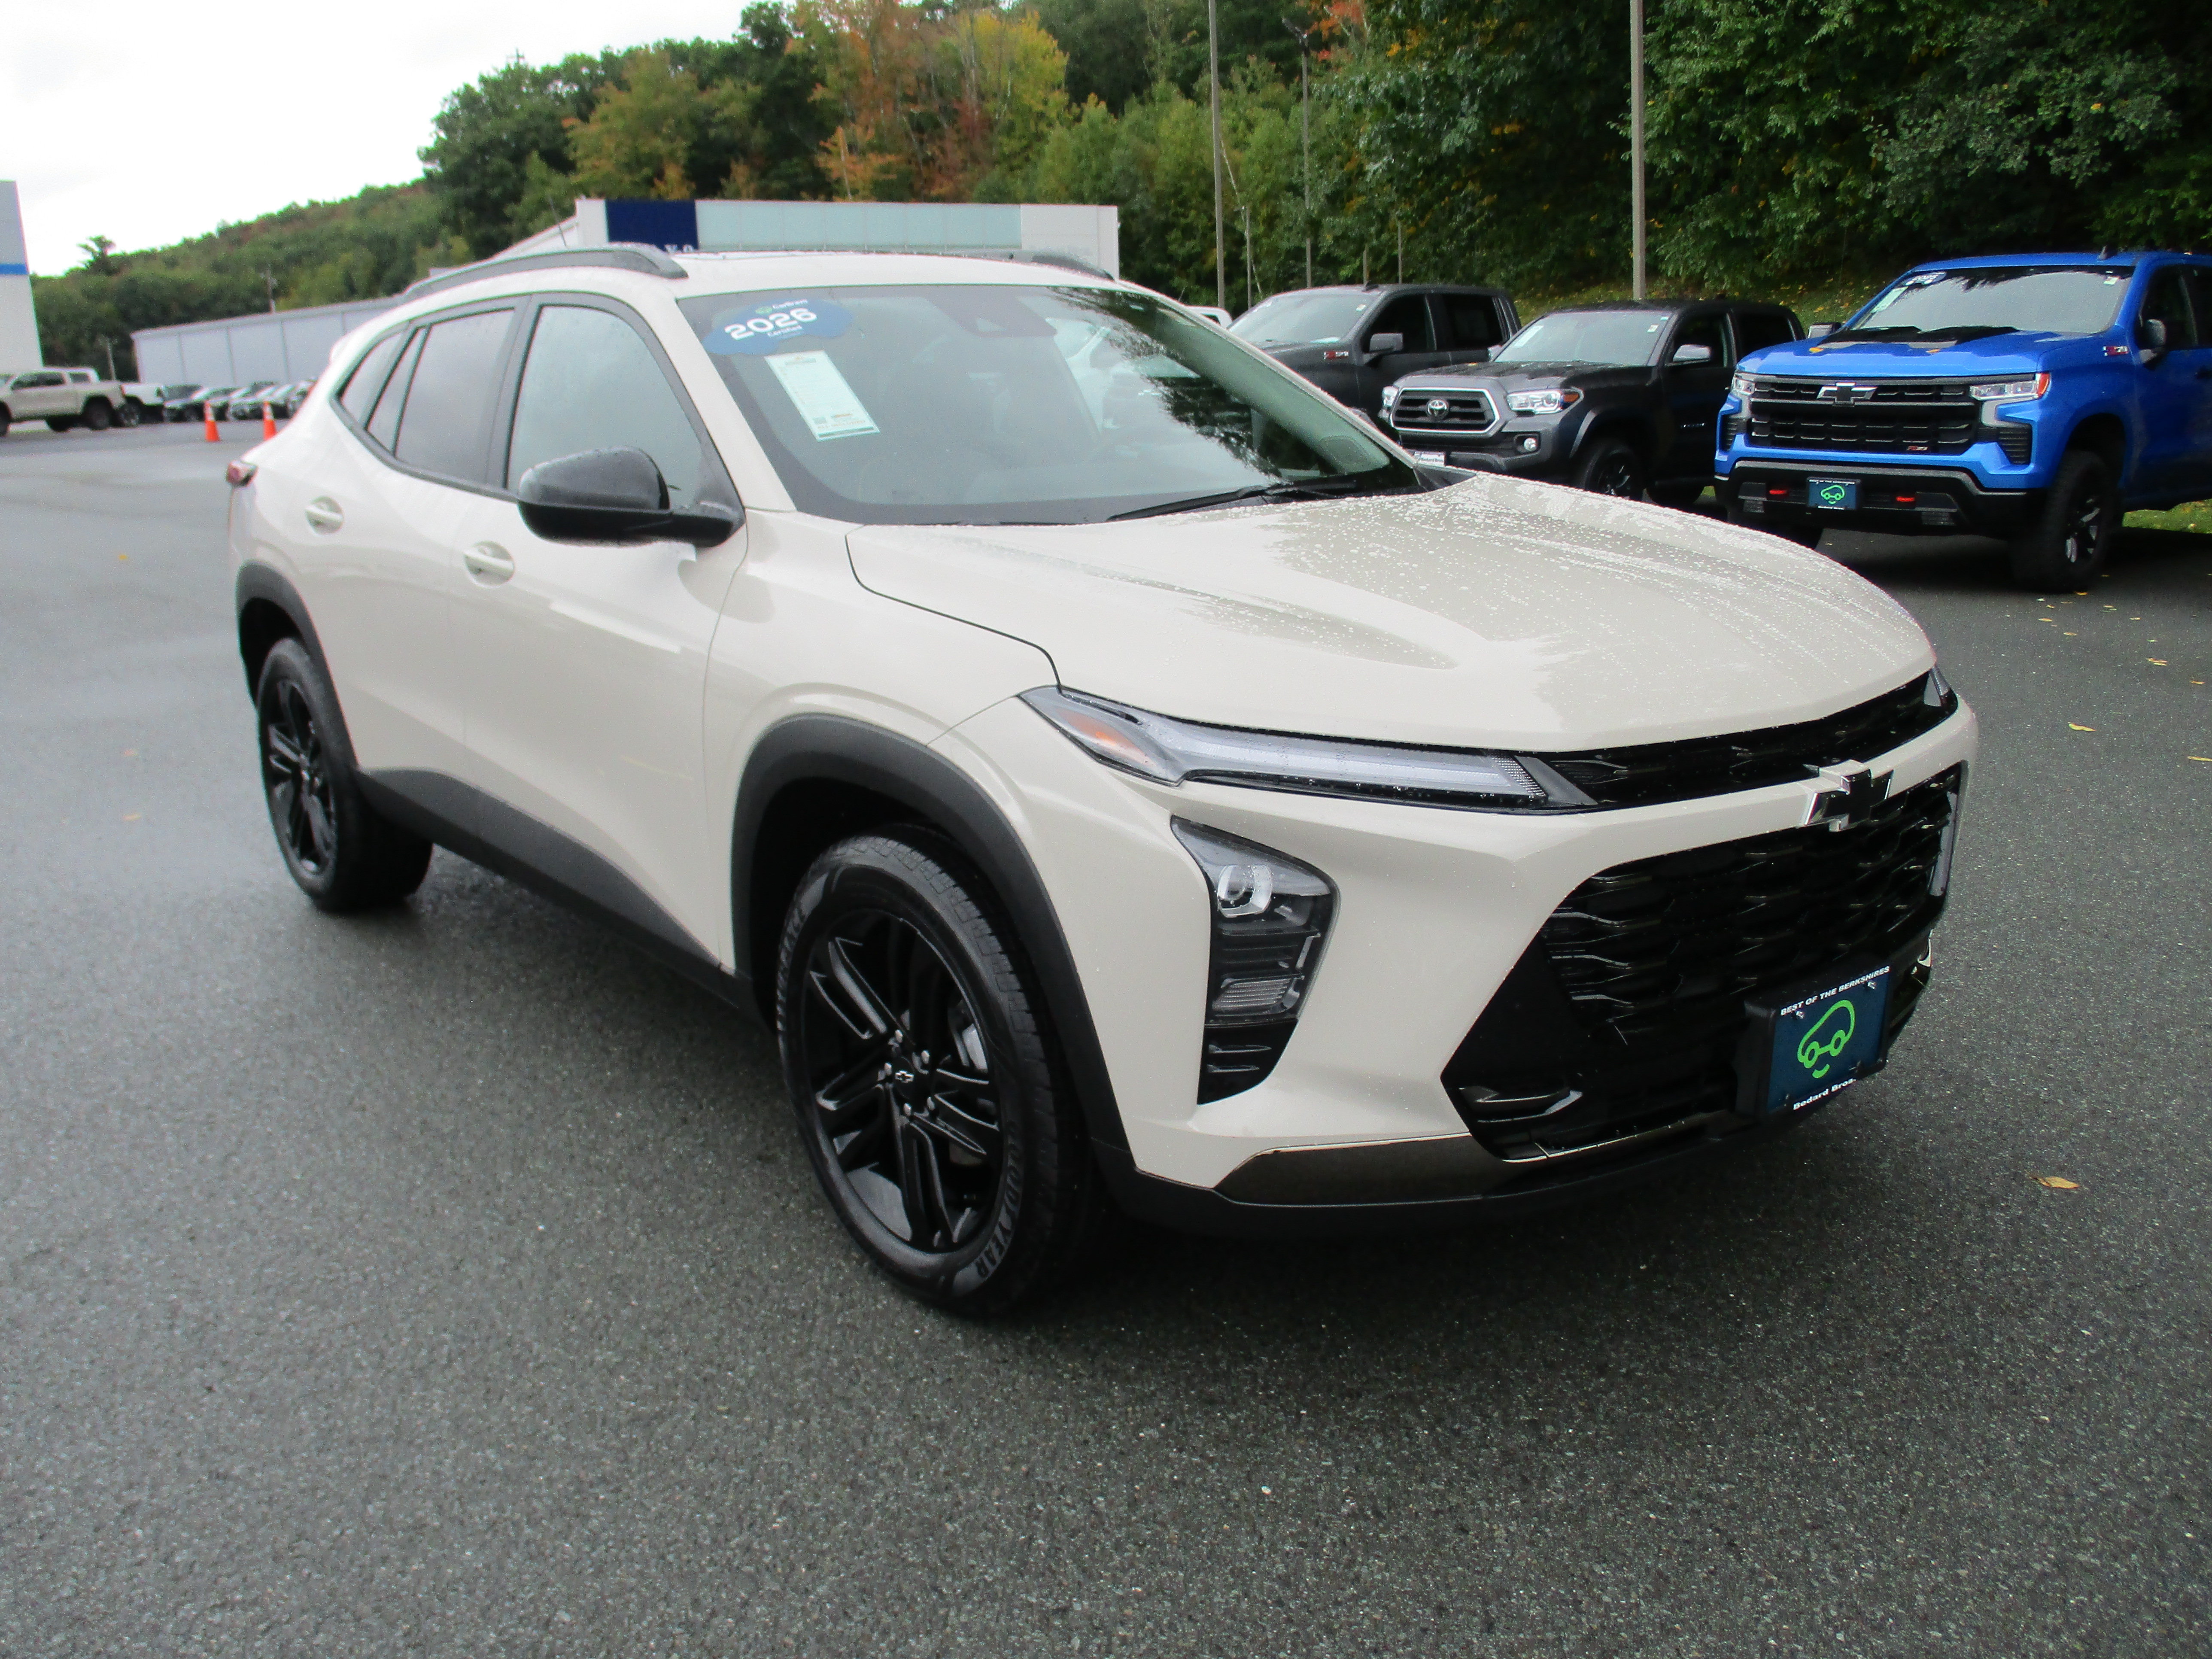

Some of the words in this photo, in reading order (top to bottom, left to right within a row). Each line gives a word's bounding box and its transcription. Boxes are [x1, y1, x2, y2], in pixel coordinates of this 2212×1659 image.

[724, 308, 817, 340] 2026
[1781, 1000, 1804, 1016] BEST
[1805, 995, 1818, 1005] OF
[1820, 988, 1837, 1000] THE
[1838, 966, 1890, 992] BERKSHIRES
[1793, 1088, 1829, 1110] Bedard
[1831, 1078, 1856, 1092] Bros.
[975, 1118, 1023, 1279] GOODYEAR
